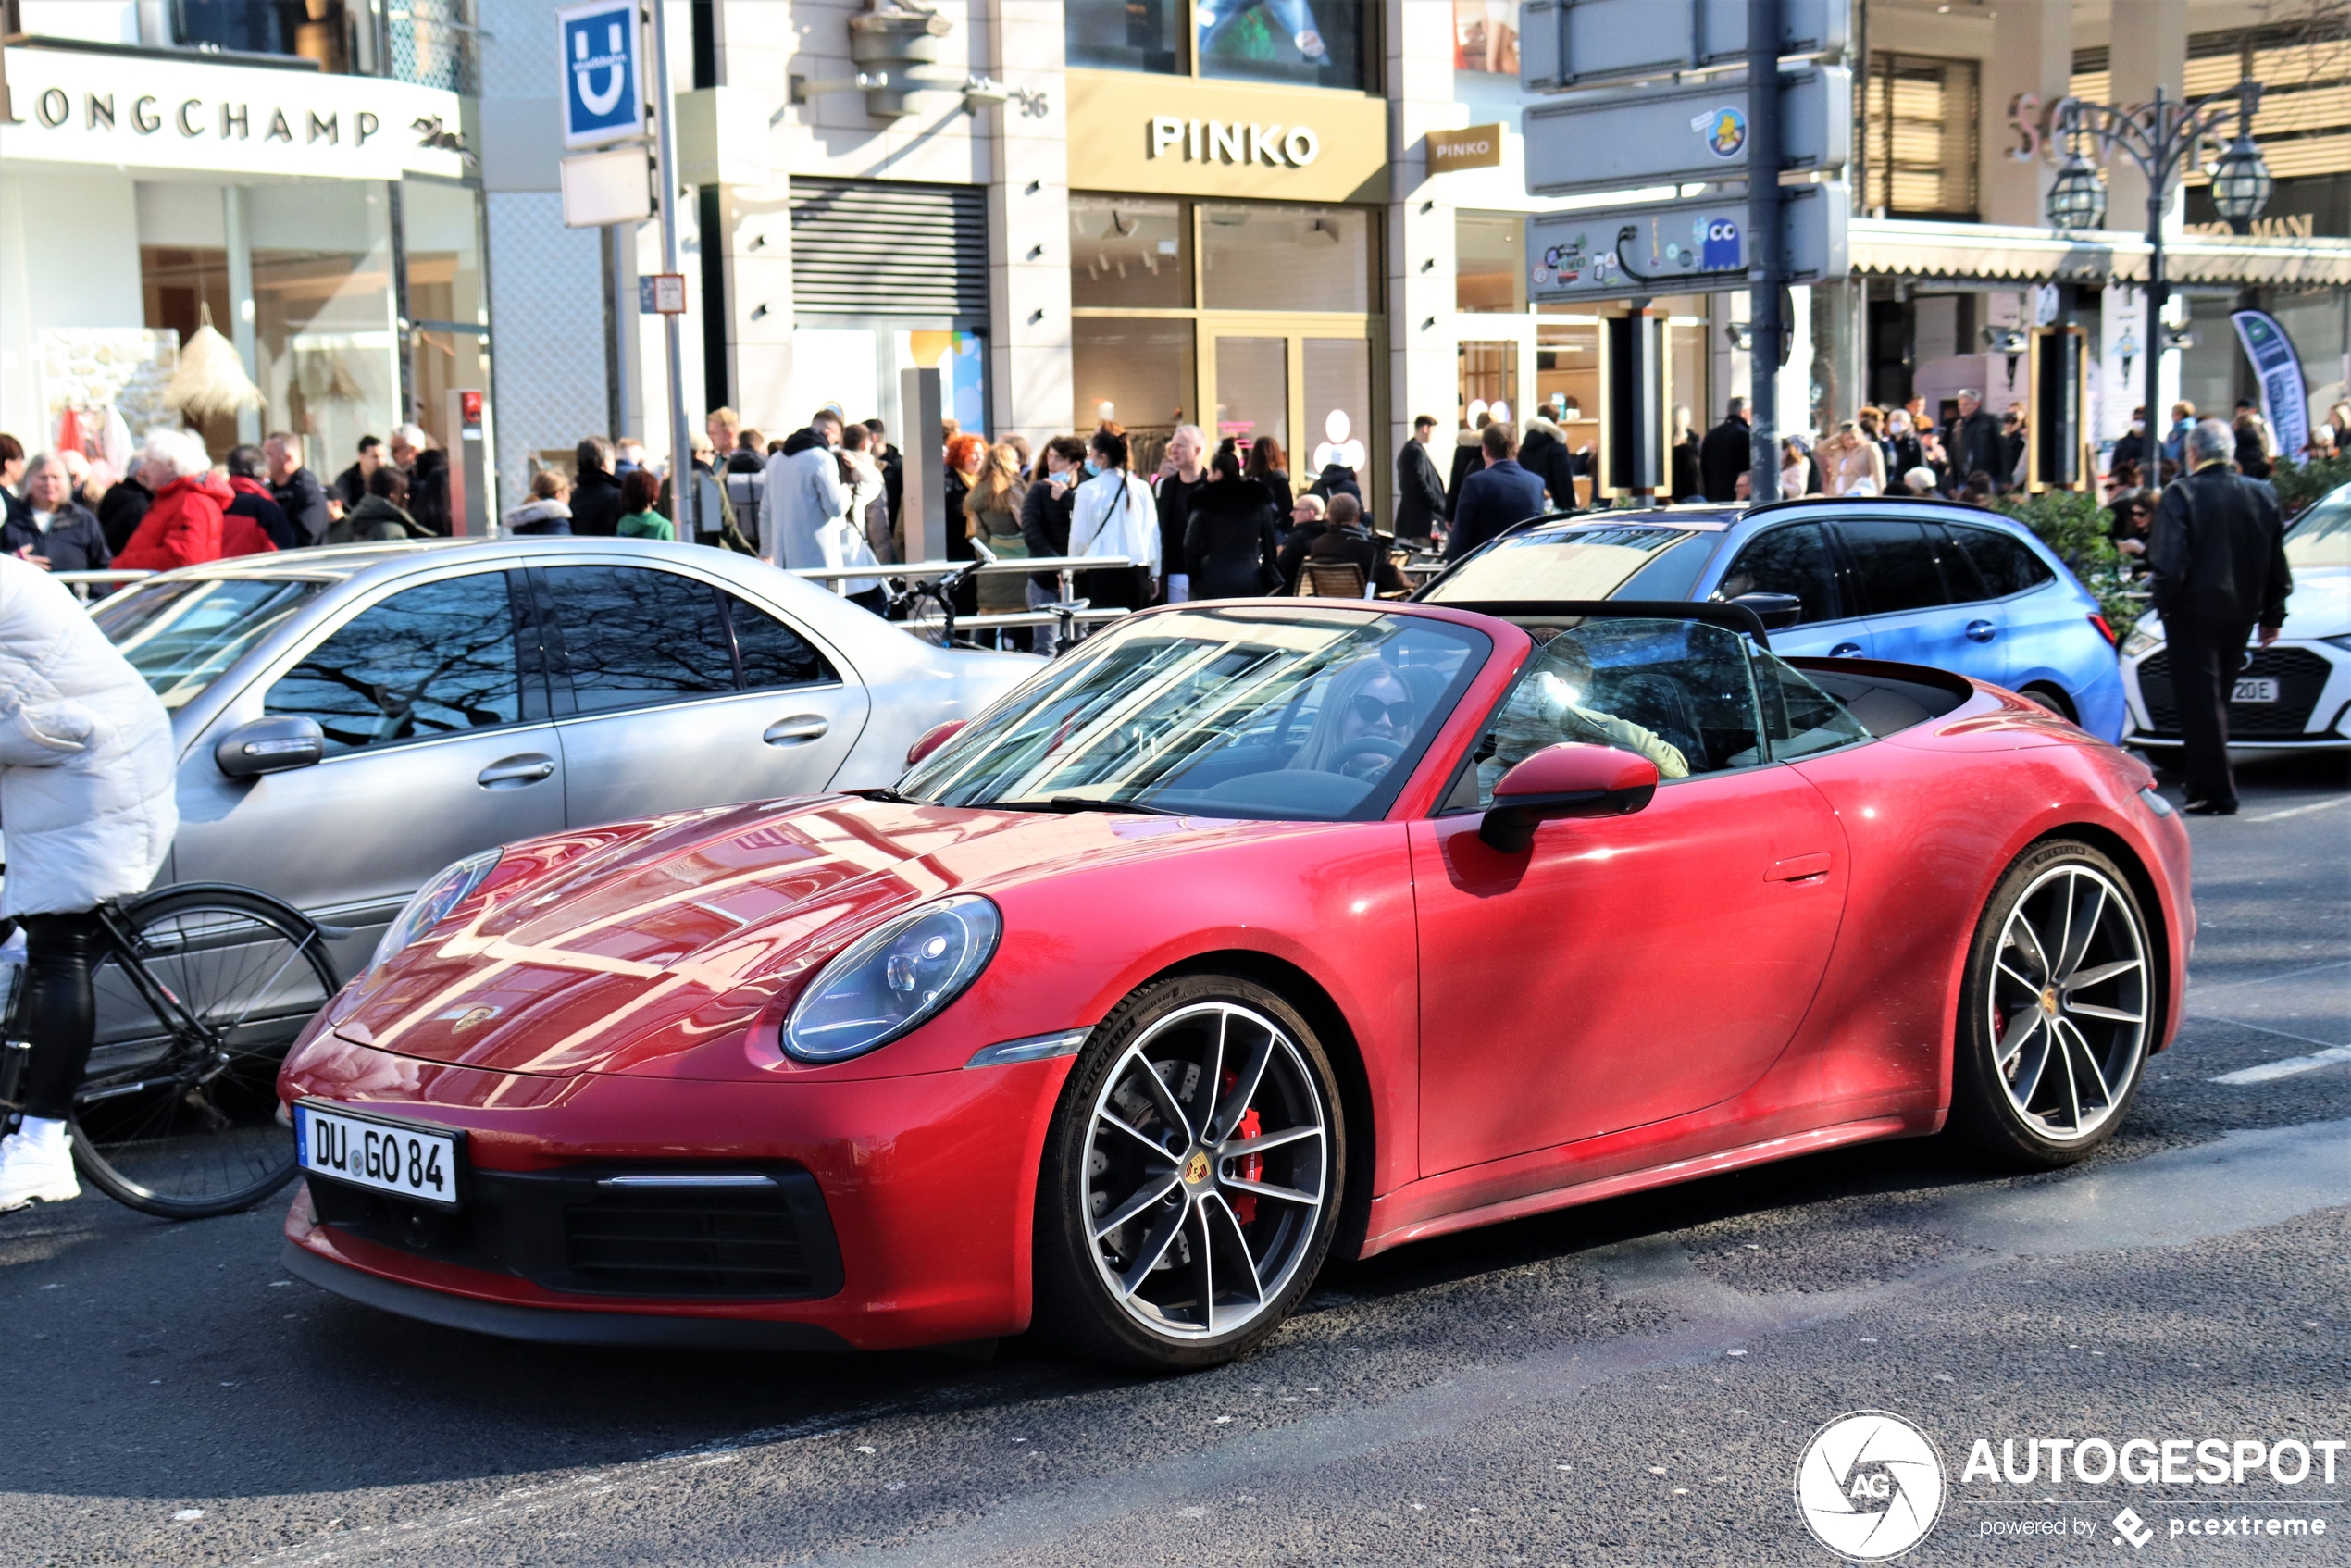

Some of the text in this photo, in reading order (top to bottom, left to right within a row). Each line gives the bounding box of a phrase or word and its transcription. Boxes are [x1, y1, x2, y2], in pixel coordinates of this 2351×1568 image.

[3, 84, 379, 148] LONGCHAMP
[1151, 115, 1320, 168] PINKO
[1437, 140, 1489, 159] PINKO
[1083, 1020, 1133, 1095] MICHELIN
[316, 1118, 443, 1192] DU GO 84
